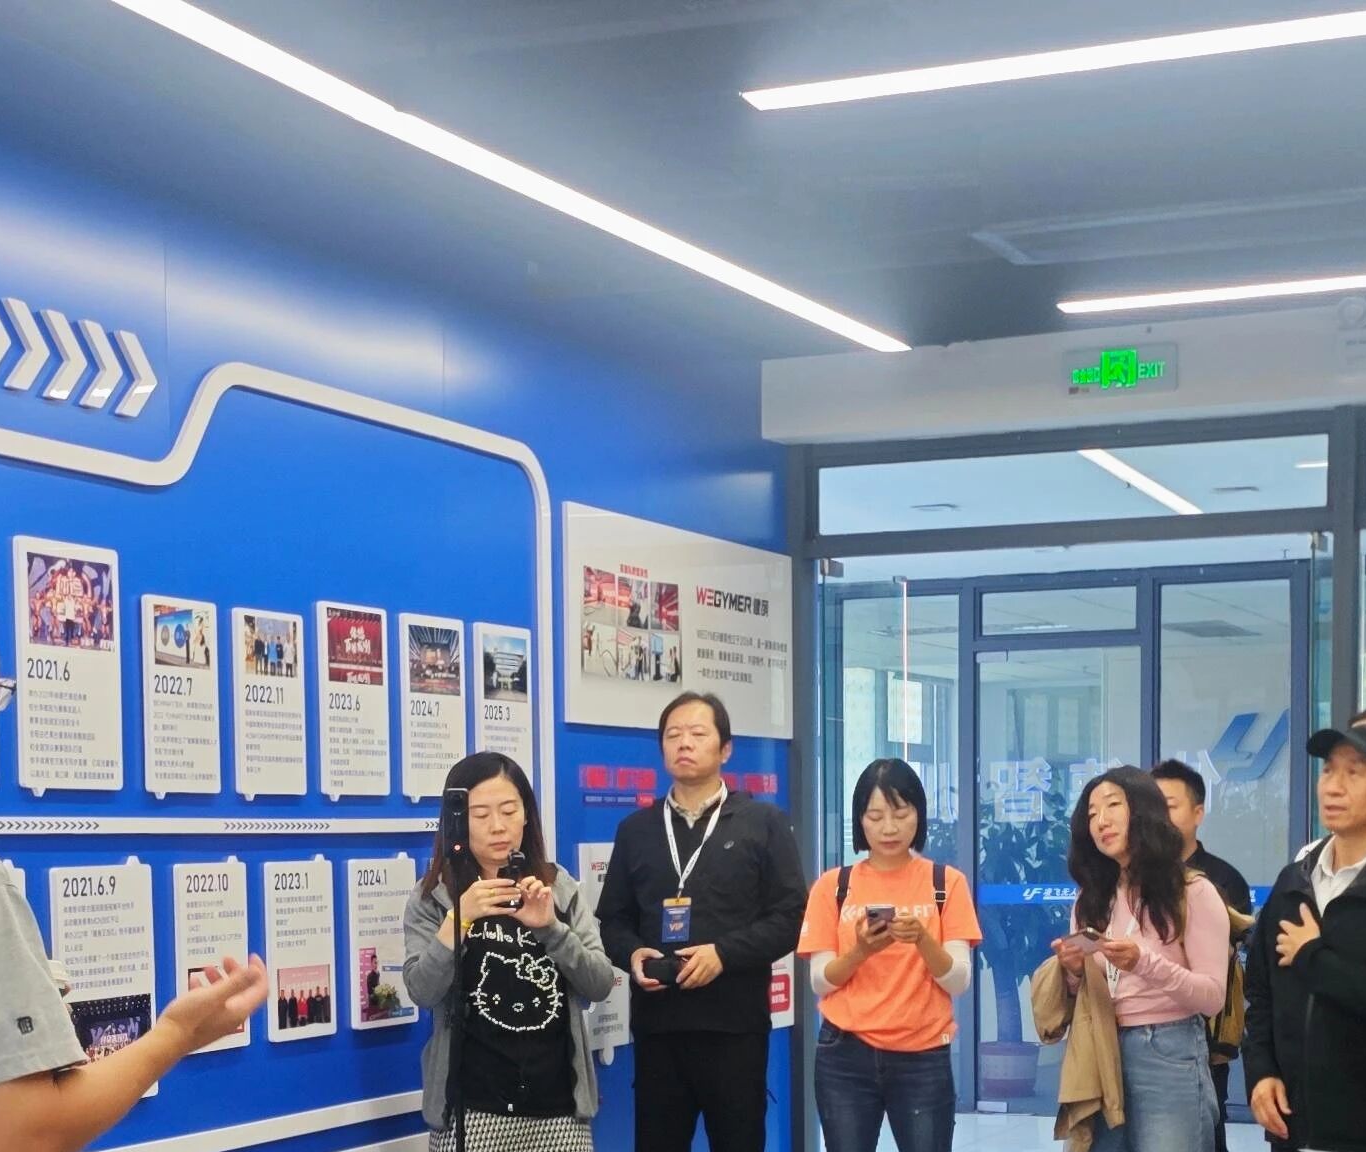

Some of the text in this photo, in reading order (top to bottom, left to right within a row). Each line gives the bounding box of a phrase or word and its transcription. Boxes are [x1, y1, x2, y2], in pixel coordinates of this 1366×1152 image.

[1138, 361, 1166, 379] EXIT
[696, 585, 752, 614] WEGYMER
[27, 658, 71, 682] 2021.6
[154, 674, 193, 696] 2022.7
[245, 684, 284, 705] 2022.11
[329, 692, 361, 711] 2023.6
[410, 700, 440, 717] 2024.7
[484, 705, 511, 721] 2025.3
[62, 876, 116, 898] 2021.6.9
[186, 873, 229, 893] 2022.10
[274, 872, 310, 891] 2023.1
[357, 869, 388, 887] 2024.1
